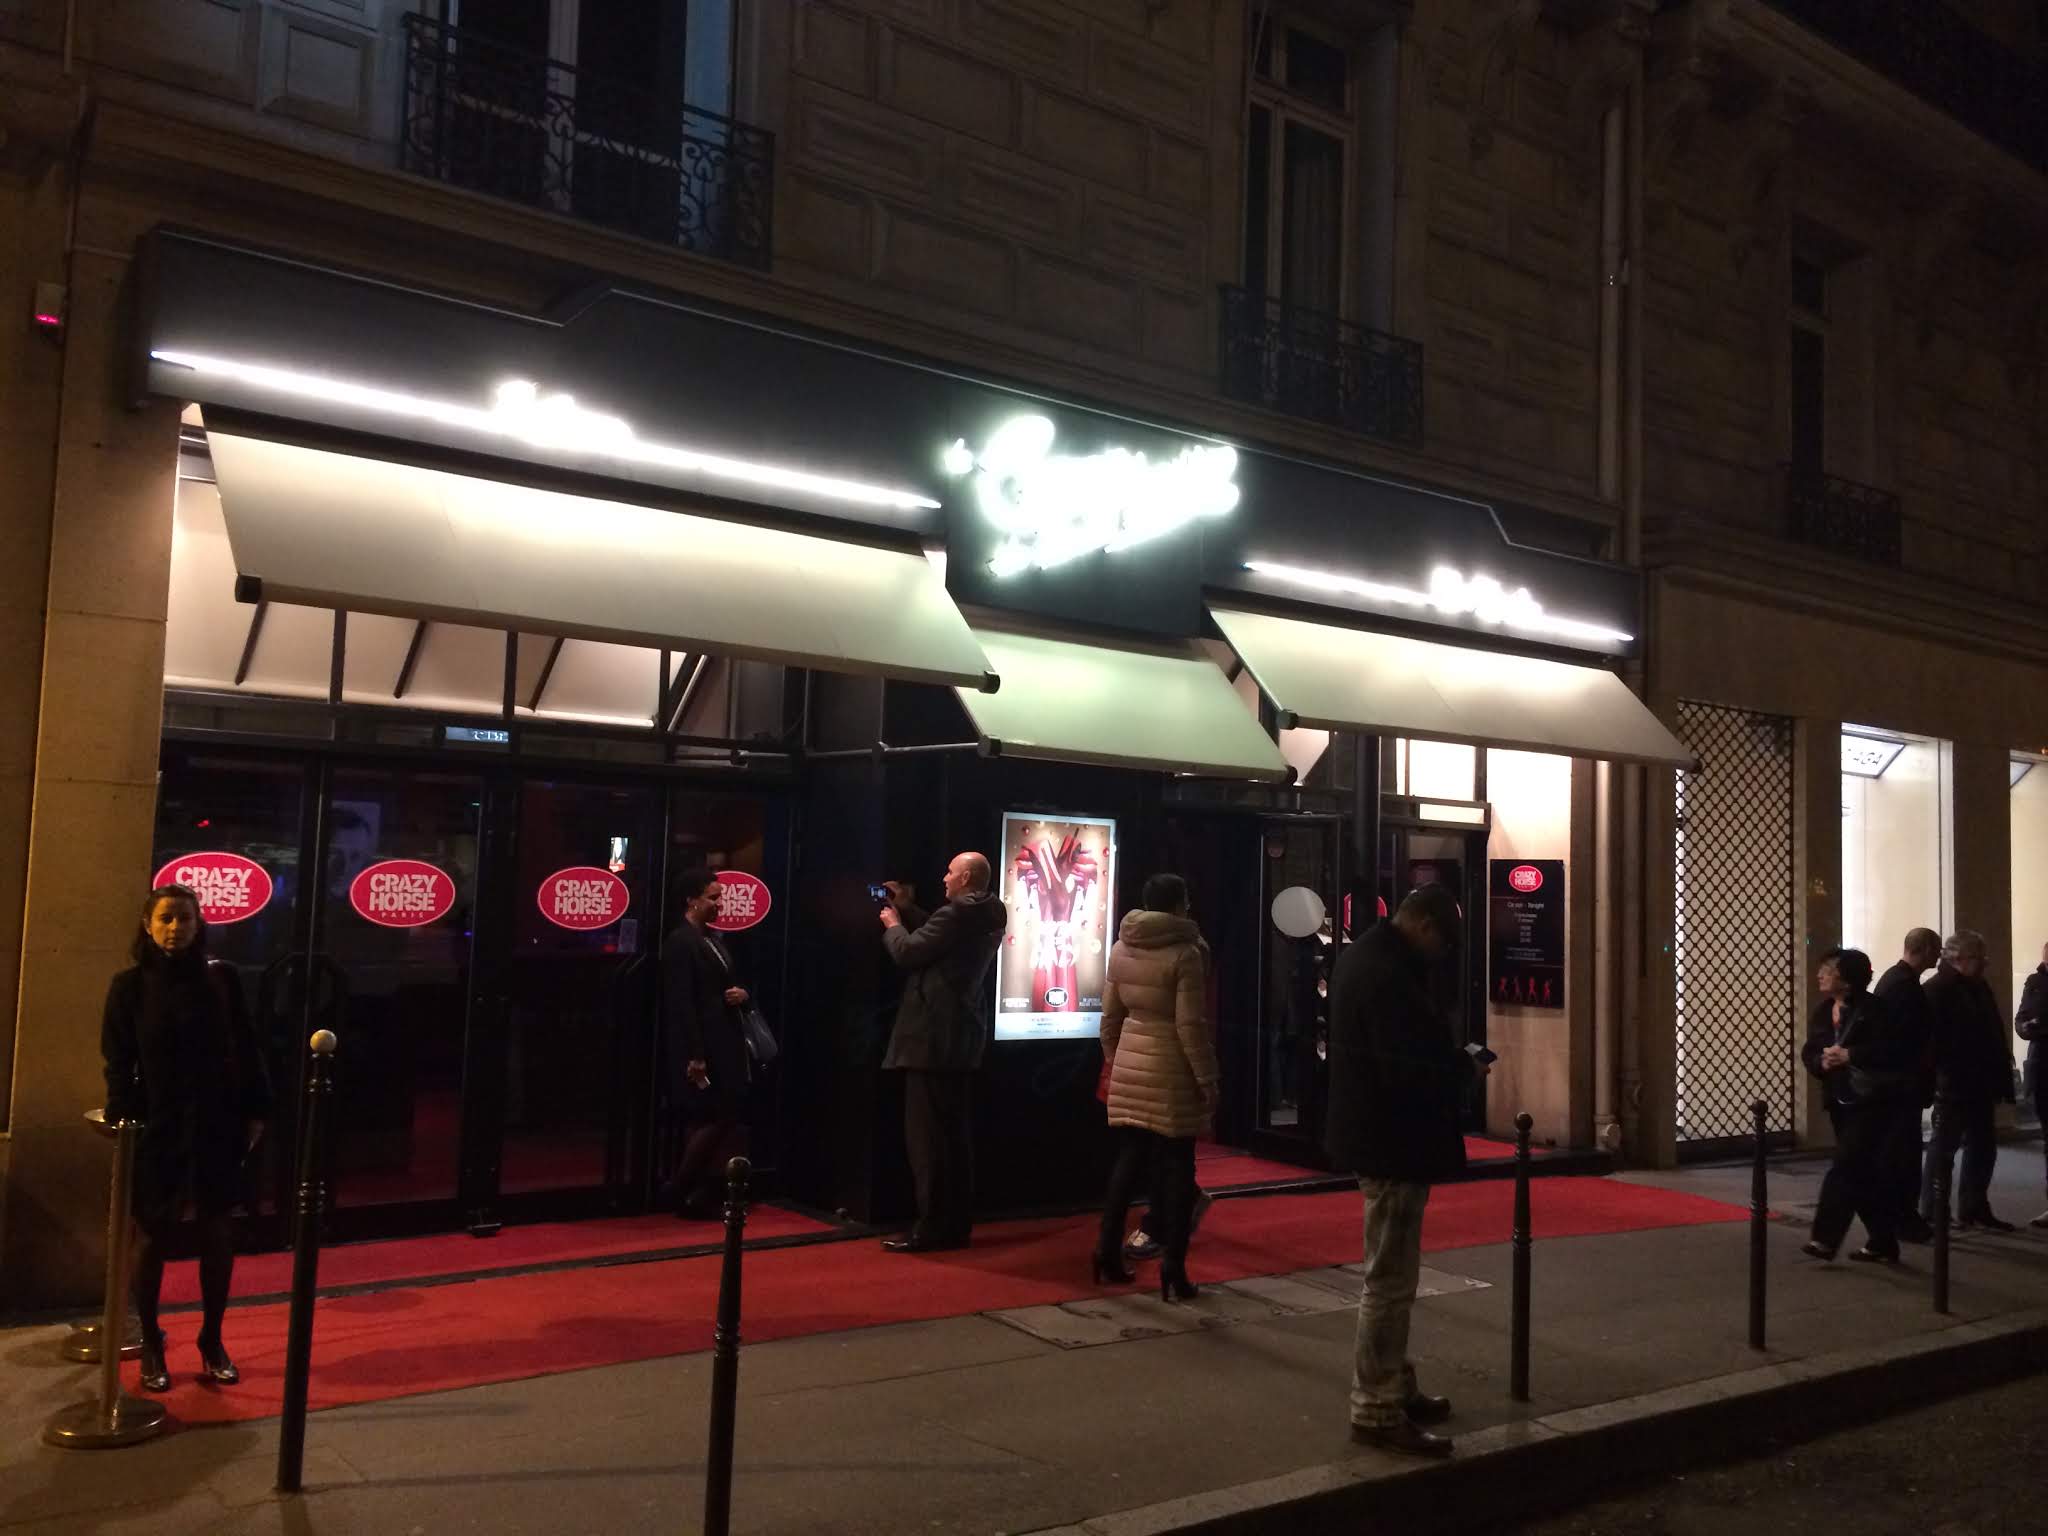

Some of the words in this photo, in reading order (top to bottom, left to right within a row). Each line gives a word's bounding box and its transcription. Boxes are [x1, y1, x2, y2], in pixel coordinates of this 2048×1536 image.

[175, 866, 252, 888] CRAZY
[369, 873, 438, 893] CRAZY
[1514, 870, 1537, 880] CRAZY
[1514, 878, 1537, 887] HORSE
[194, 886, 250, 908] ORSE
[554, 879, 614, 898] CRAZY
[720, 883, 757, 901] RAZY
[368, 892, 436, 911] HORSE
[554, 896, 613, 915] HORSE
[717, 899, 756, 917] ORSE
